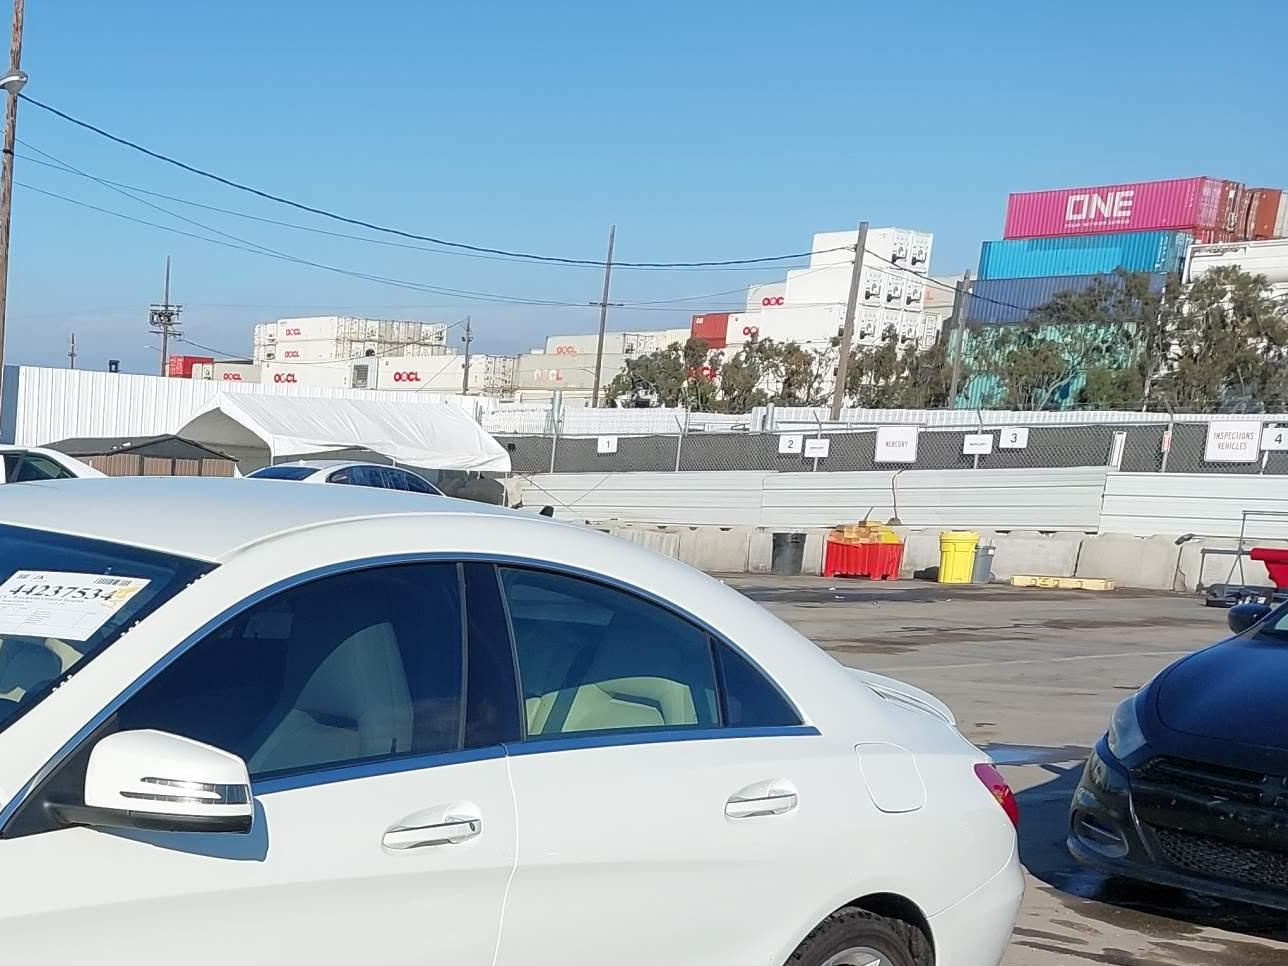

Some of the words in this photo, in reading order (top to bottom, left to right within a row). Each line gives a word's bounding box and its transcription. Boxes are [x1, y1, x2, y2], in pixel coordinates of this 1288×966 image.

[1065, 190, 1134, 221] ONE
[762, 297, 785, 306] OOC
[273, 373, 298, 383] OOCL
[393, 371, 421, 382] OOCL
[1010, 433, 1018, 443] 3
[1274, 433, 1283, 445] 4
[787, 440, 795, 449] 2
[1217, 442, 1248, 450] VEHICLES
[9, 584, 117, 601] 44237534
